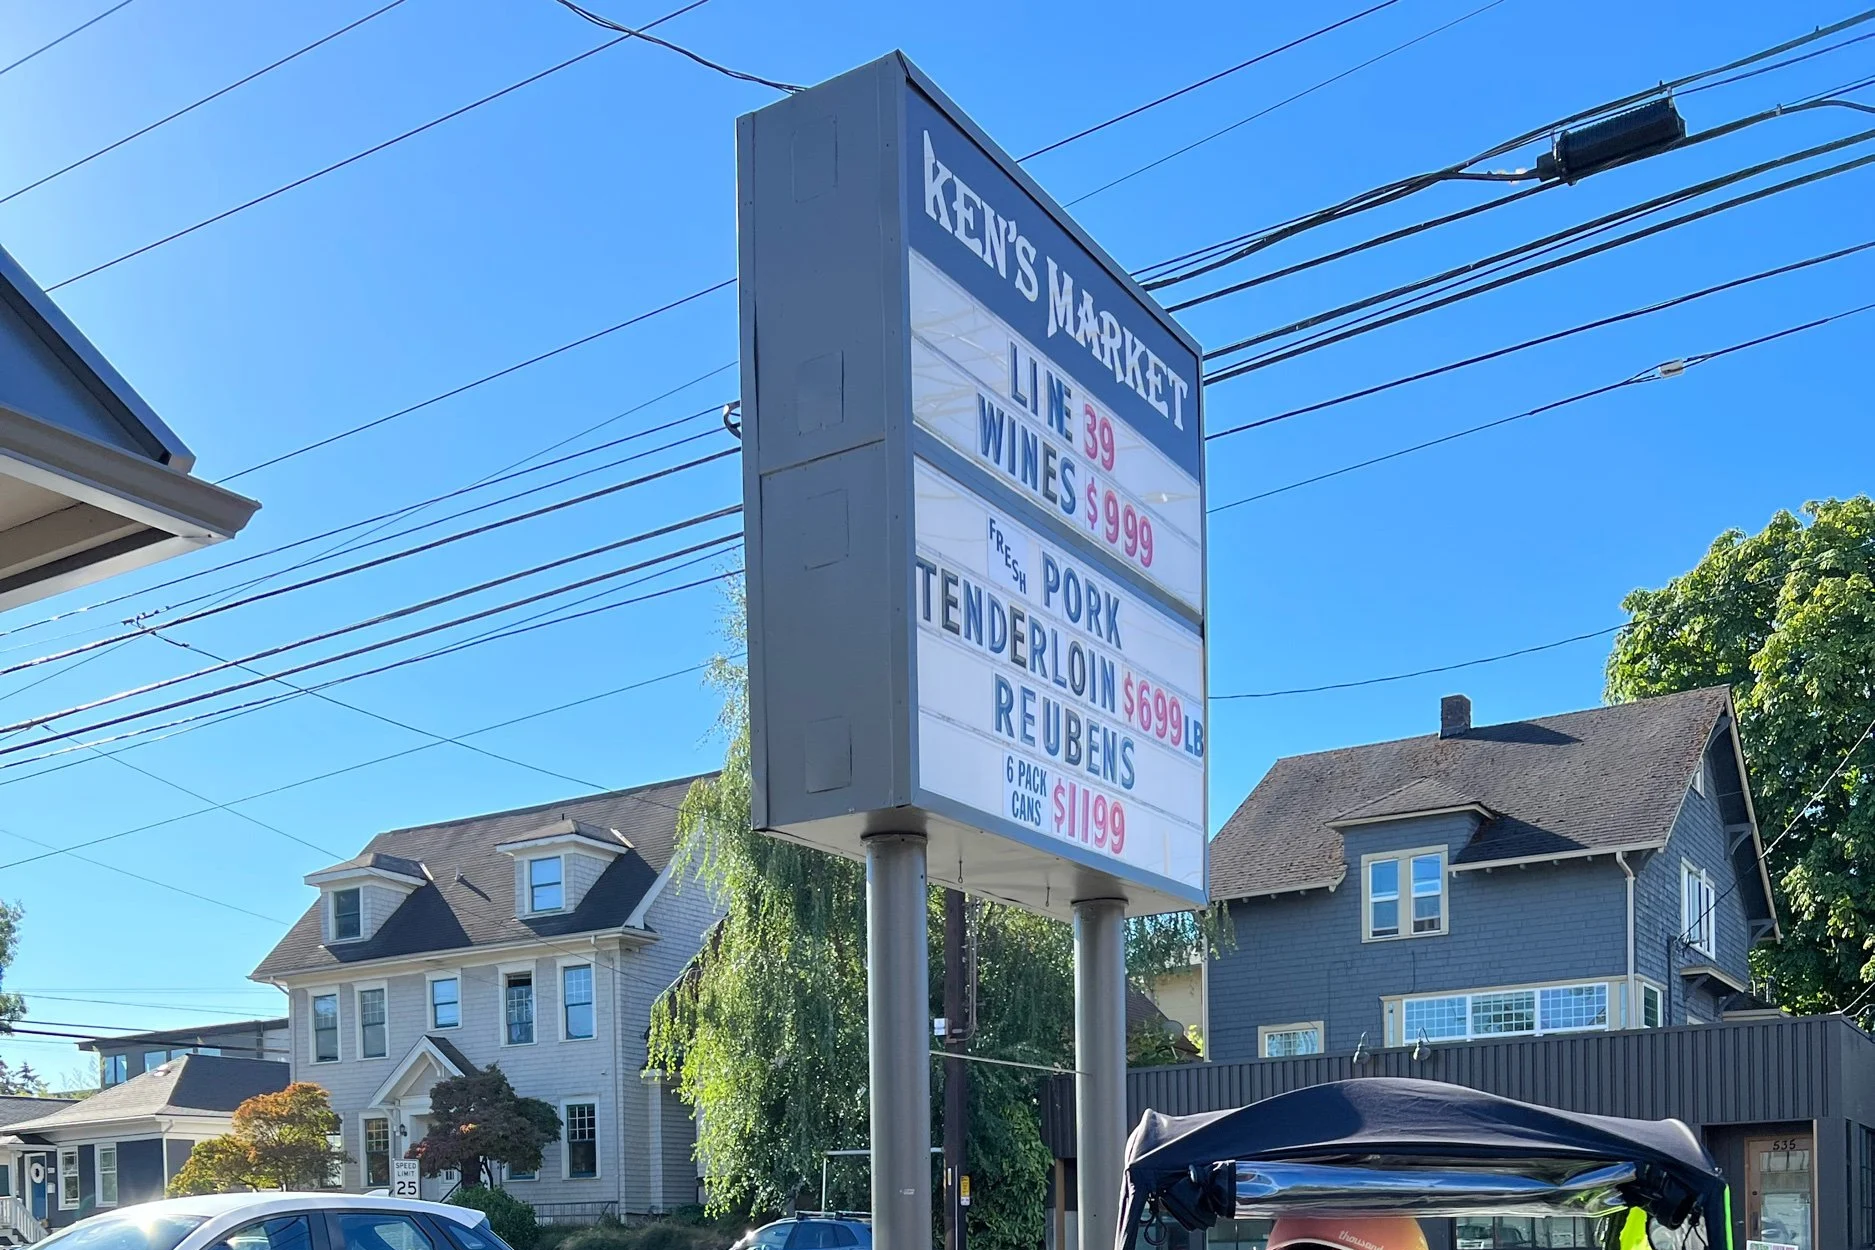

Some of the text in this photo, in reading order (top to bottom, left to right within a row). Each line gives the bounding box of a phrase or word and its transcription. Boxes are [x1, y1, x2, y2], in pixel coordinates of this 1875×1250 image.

[924, 130, 1189, 431] KEN'S MARKET
[1010, 340, 1115, 472] LINE 39
[977, 392, 1153, 568] WINES $999
[989, 517, 1122, 650] FRESH PORK
[915, 558, 1204, 758] TENDERLOIN $699 LB
[994, 673, 1135, 790] REUBENS
[1006, 755, 1047, 798] 6 PACK
[1011, 790, 1042, 827] CANS
[1053, 777, 1126, 855] $1199
[395, 1162, 417, 1170] SPEED
[397, 1181, 417, 1195] 25
[1773, 1139, 1796, 1150] 535
